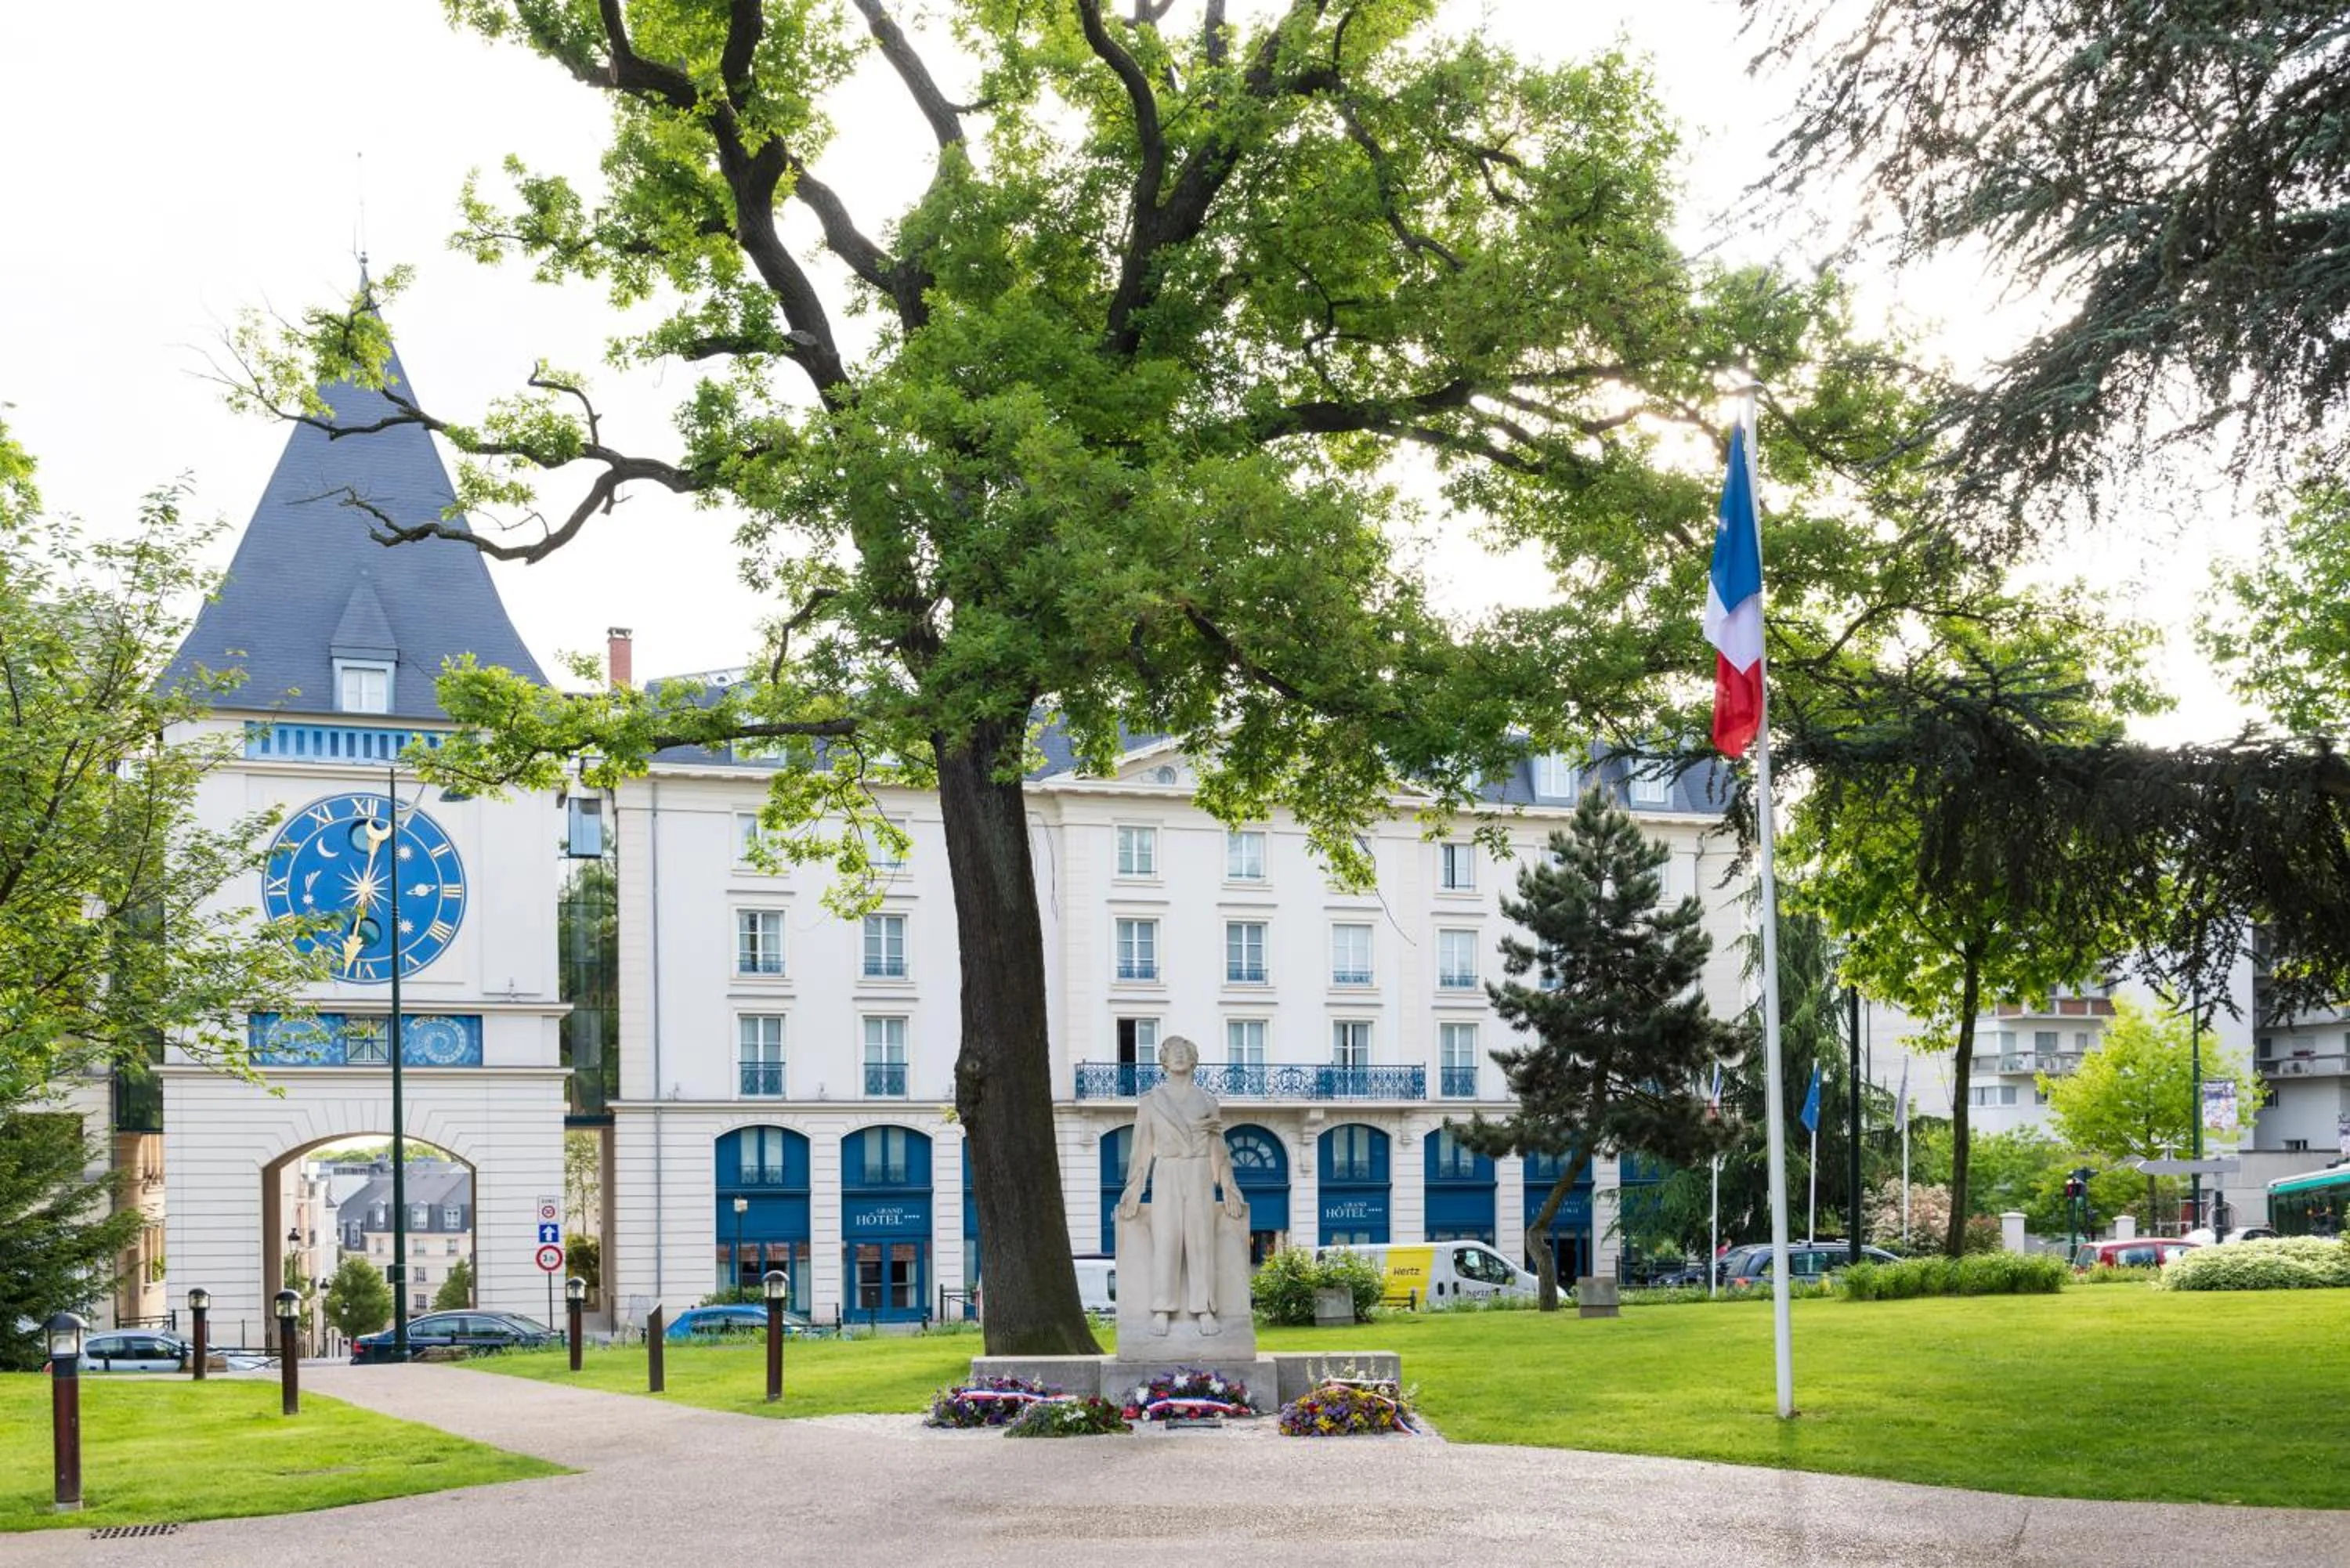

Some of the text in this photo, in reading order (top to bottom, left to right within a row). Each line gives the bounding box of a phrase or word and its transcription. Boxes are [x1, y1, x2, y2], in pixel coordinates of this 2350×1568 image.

[350, 798, 378, 817] XII
[306, 804, 334, 829] XI
[431, 843, 450, 858] II
[267, 875, 289, 896] IX
[443, 883, 463, 898] III
[856, 1212, 903, 1226] HÔTEL
[1325, 1205, 1366, 1218] HÔTEL
[1393, 1267, 1421, 1276] Hertz
